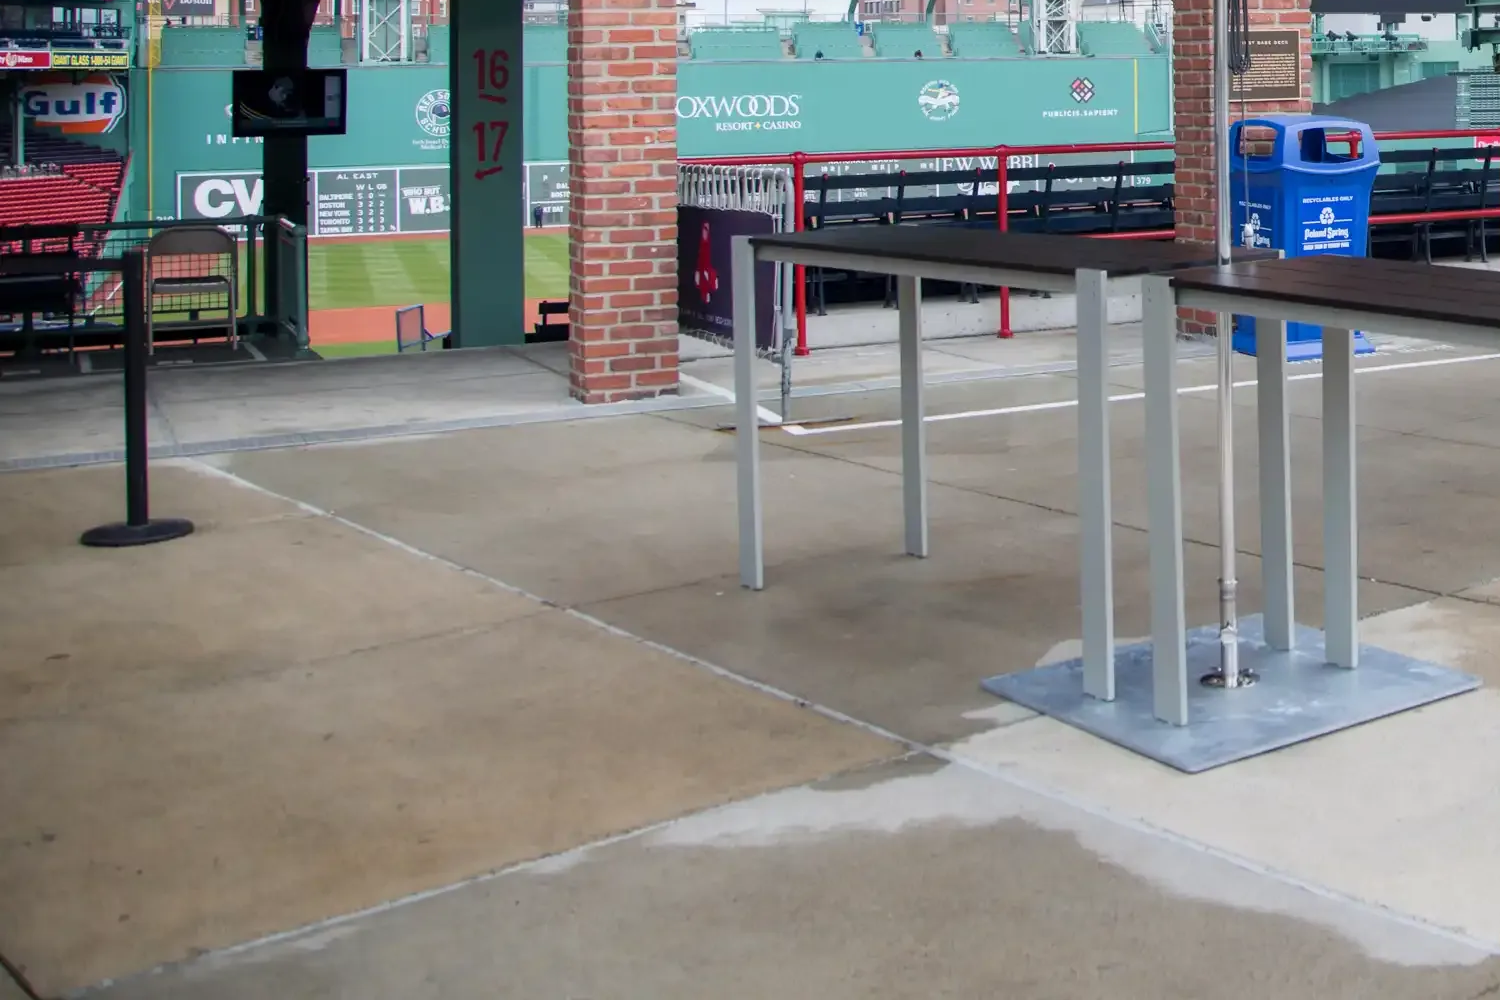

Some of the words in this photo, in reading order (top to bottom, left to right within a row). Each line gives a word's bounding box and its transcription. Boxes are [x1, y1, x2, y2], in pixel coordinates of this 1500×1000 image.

[473, 48, 509, 90] 16
[23, 90, 118, 115] Gulf
[675, 94, 800, 118] OXWOODS
[716, 121, 753, 131] RESORT
[763, 120, 802, 130] CASINO
[473, 121, 509, 162] 17
[979, 155, 1033, 170] WBB
[1136, 177, 1151, 185] 379
[1304, 228, 1327, 240] Poland
[1327, 227, 1349, 239] Spring
